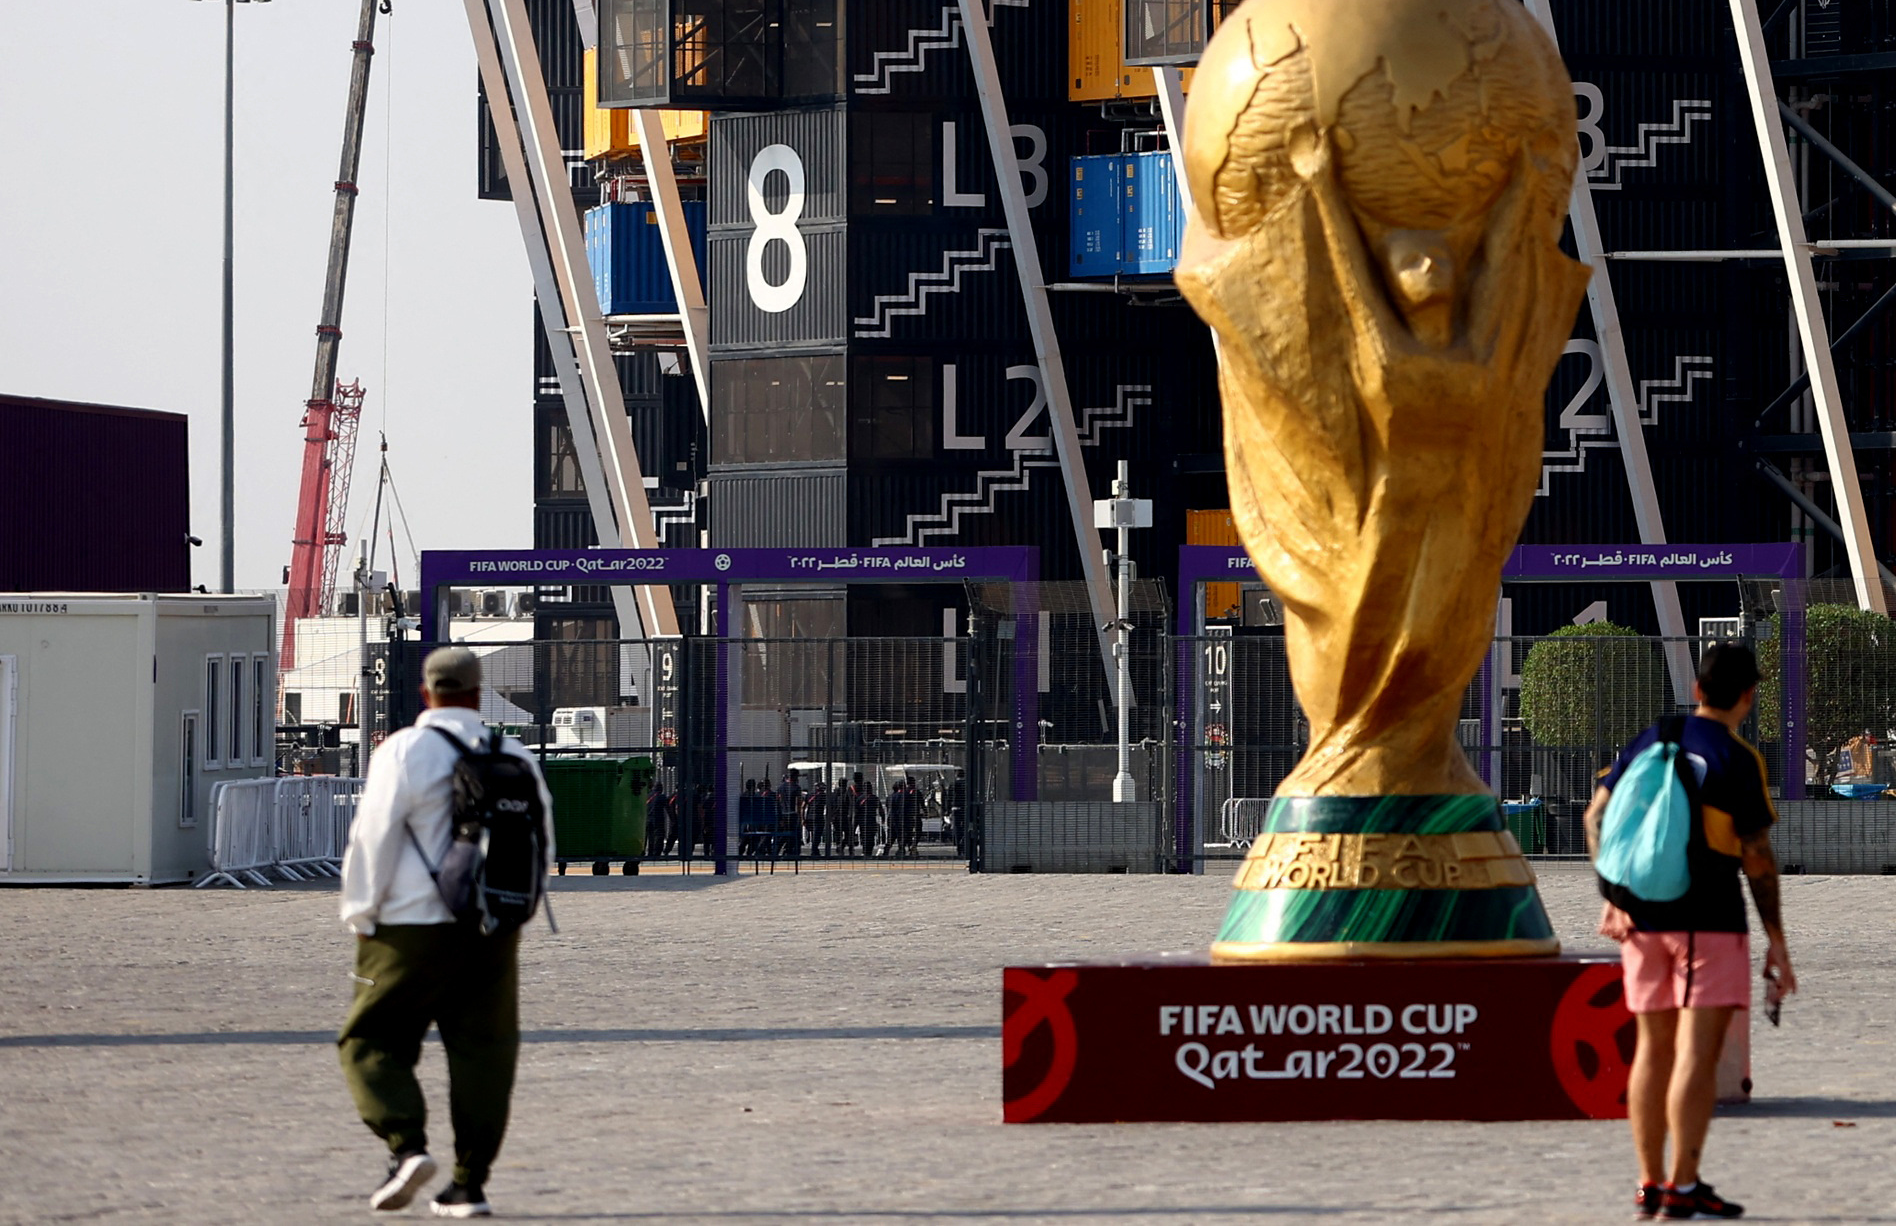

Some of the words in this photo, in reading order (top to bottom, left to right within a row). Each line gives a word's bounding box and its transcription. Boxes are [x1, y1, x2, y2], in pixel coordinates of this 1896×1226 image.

[746, 143, 807, 313] 8
[942, 363, 1053, 450] L2
[470, 561, 497, 572] FIFA
[498, 561, 544, 572] WORLD
[545, 561, 570, 572] CUP
[863, 557, 892, 568] FIFA
[894, 556, 930, 571] العالم
[932, 554, 966, 571] كأس
[1227, 557, 1256, 569] FIFA
[1628, 554, 1657, 565] FIFA
[1659, 554, 1697, 568] العالم
[1699, 551, 1733, 568] كأس
[661, 652, 674, 682] 9
[1204, 645, 1227, 675] 10
[1293, 833, 1430, 861] FIFA
[1259, 859, 1379, 889] WORLD
[1391, 860, 1462, 889] CUP
[1158, 1004, 1246, 1036] FIFA
[1248, 1003, 1394, 1035] WORLD
[1400, 1003, 1479, 1035] CUP
